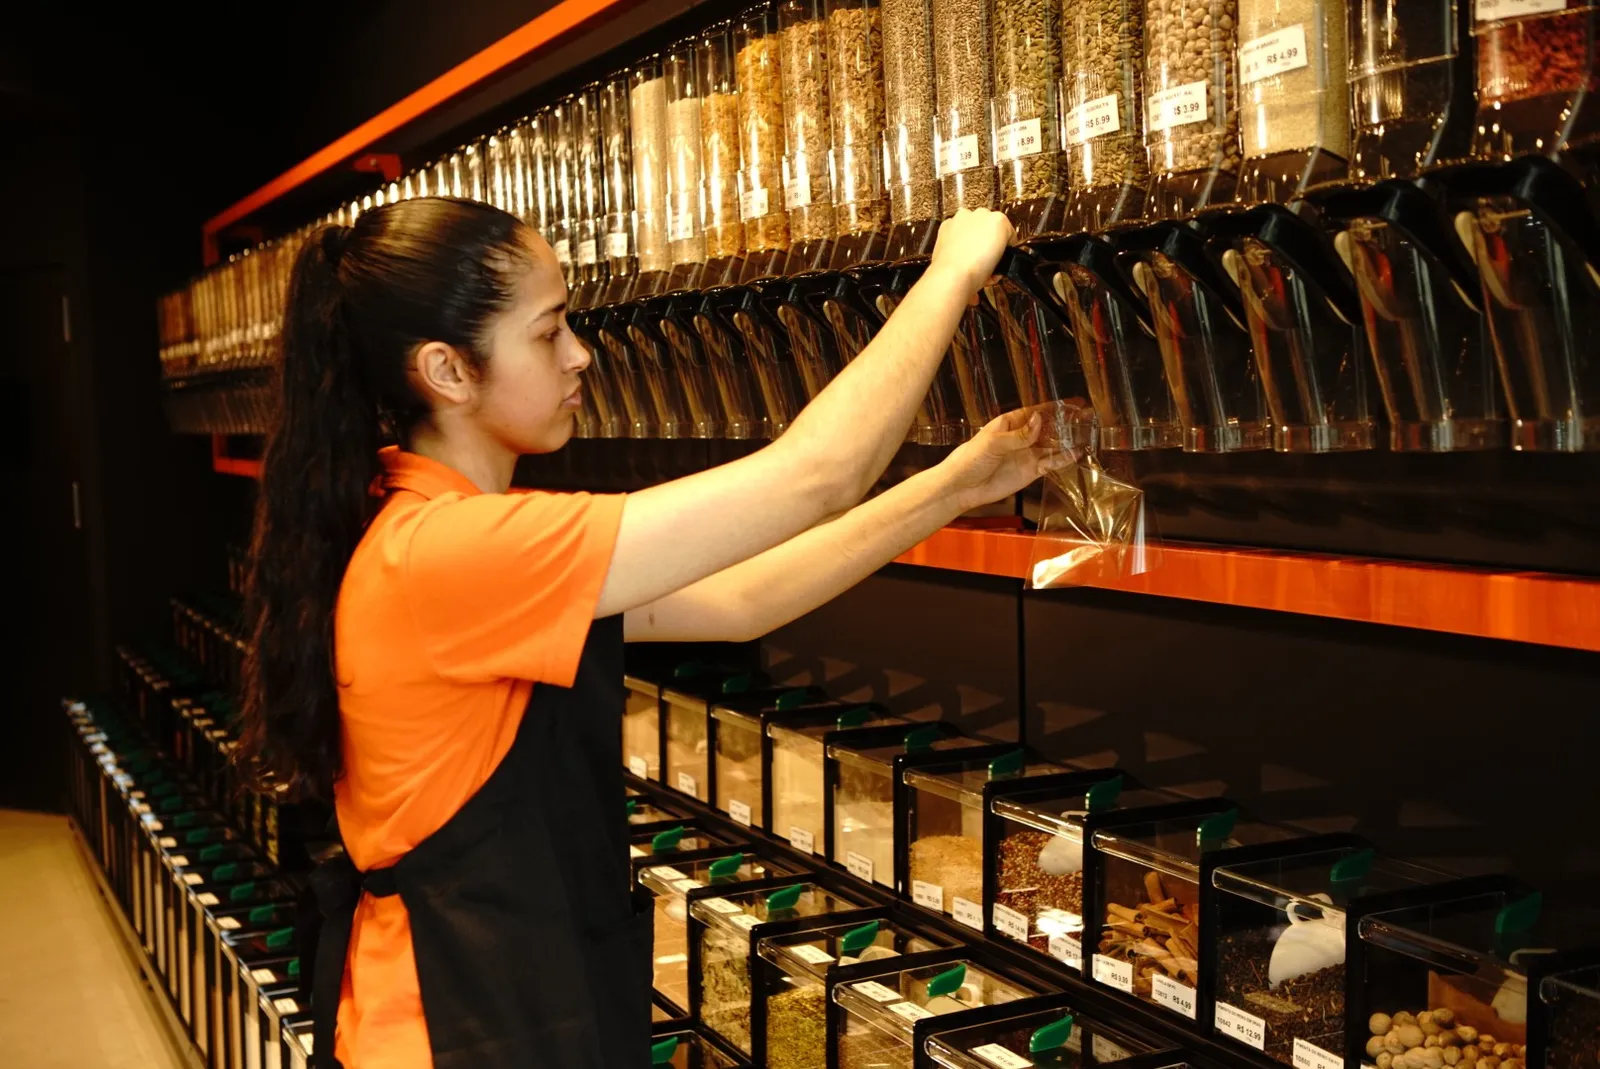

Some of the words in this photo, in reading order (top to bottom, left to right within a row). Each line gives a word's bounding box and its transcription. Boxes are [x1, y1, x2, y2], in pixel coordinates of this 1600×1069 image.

[1266, 53, 1277, 65] R$
[1280, 47, 1298, 61] 4.99
[1183, 102, 1199, 114] 3.99
[1085, 119, 1094, 129] R$
[1172, 995, 1180, 1005] R$
[1180, 999, 1192, 1010] 4.99
[1236, 1024, 1244, 1034] R$
[1245, 1028, 1261, 1041] 12.99
